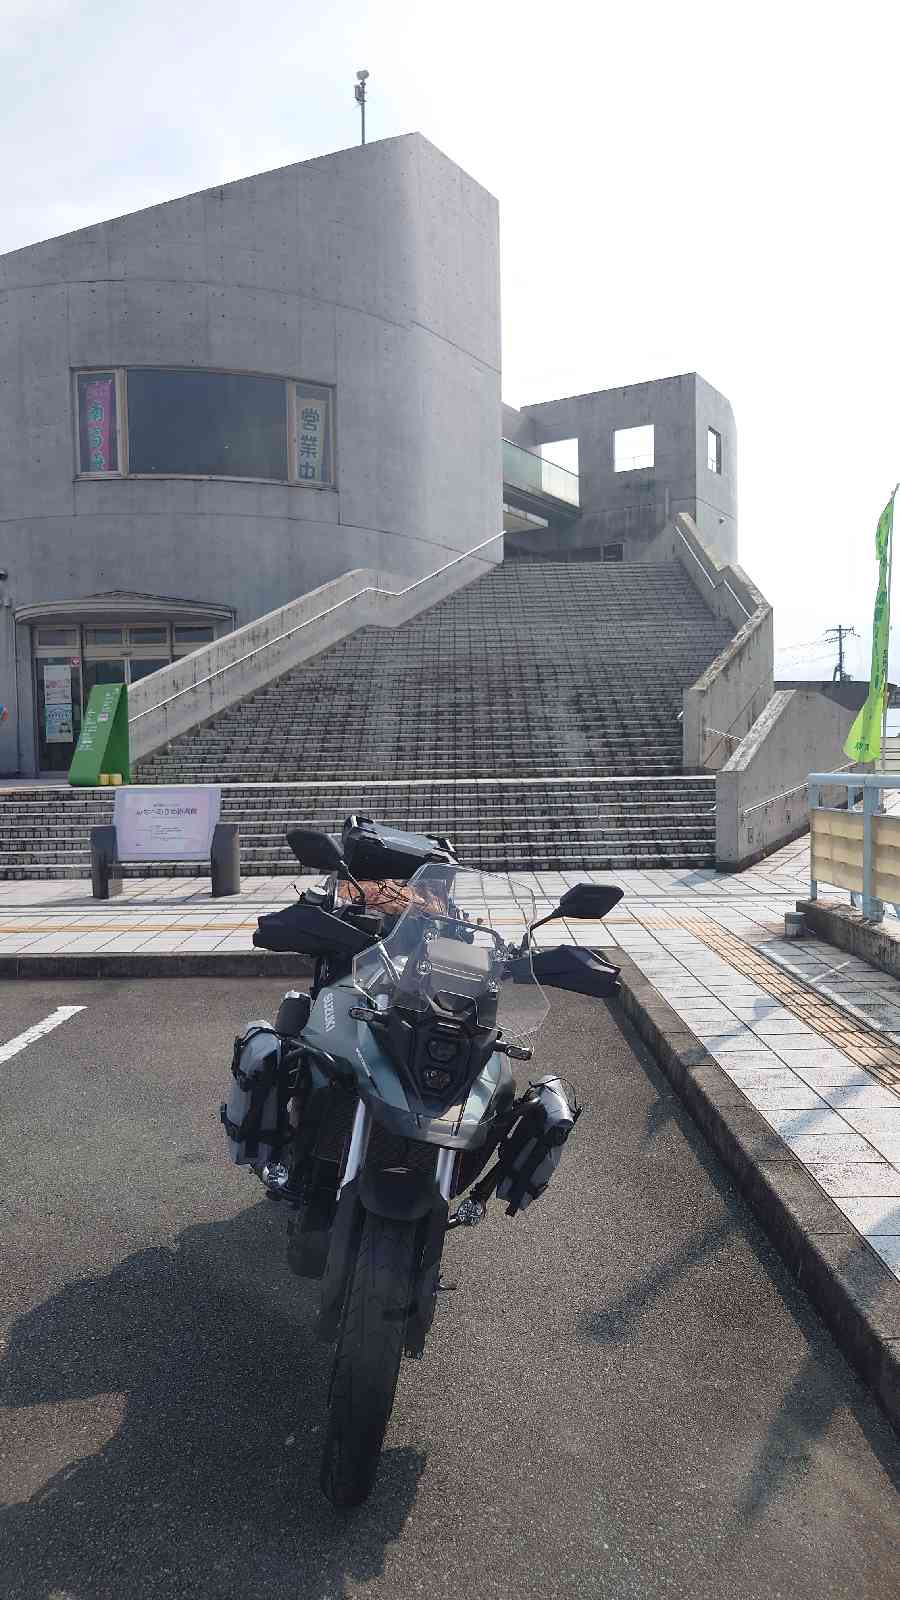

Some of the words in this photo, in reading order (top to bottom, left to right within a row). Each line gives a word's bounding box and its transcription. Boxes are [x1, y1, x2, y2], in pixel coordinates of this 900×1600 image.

[299, 408, 320, 480] 営業中
[323, 992, 336, 1032] SUZUKI
